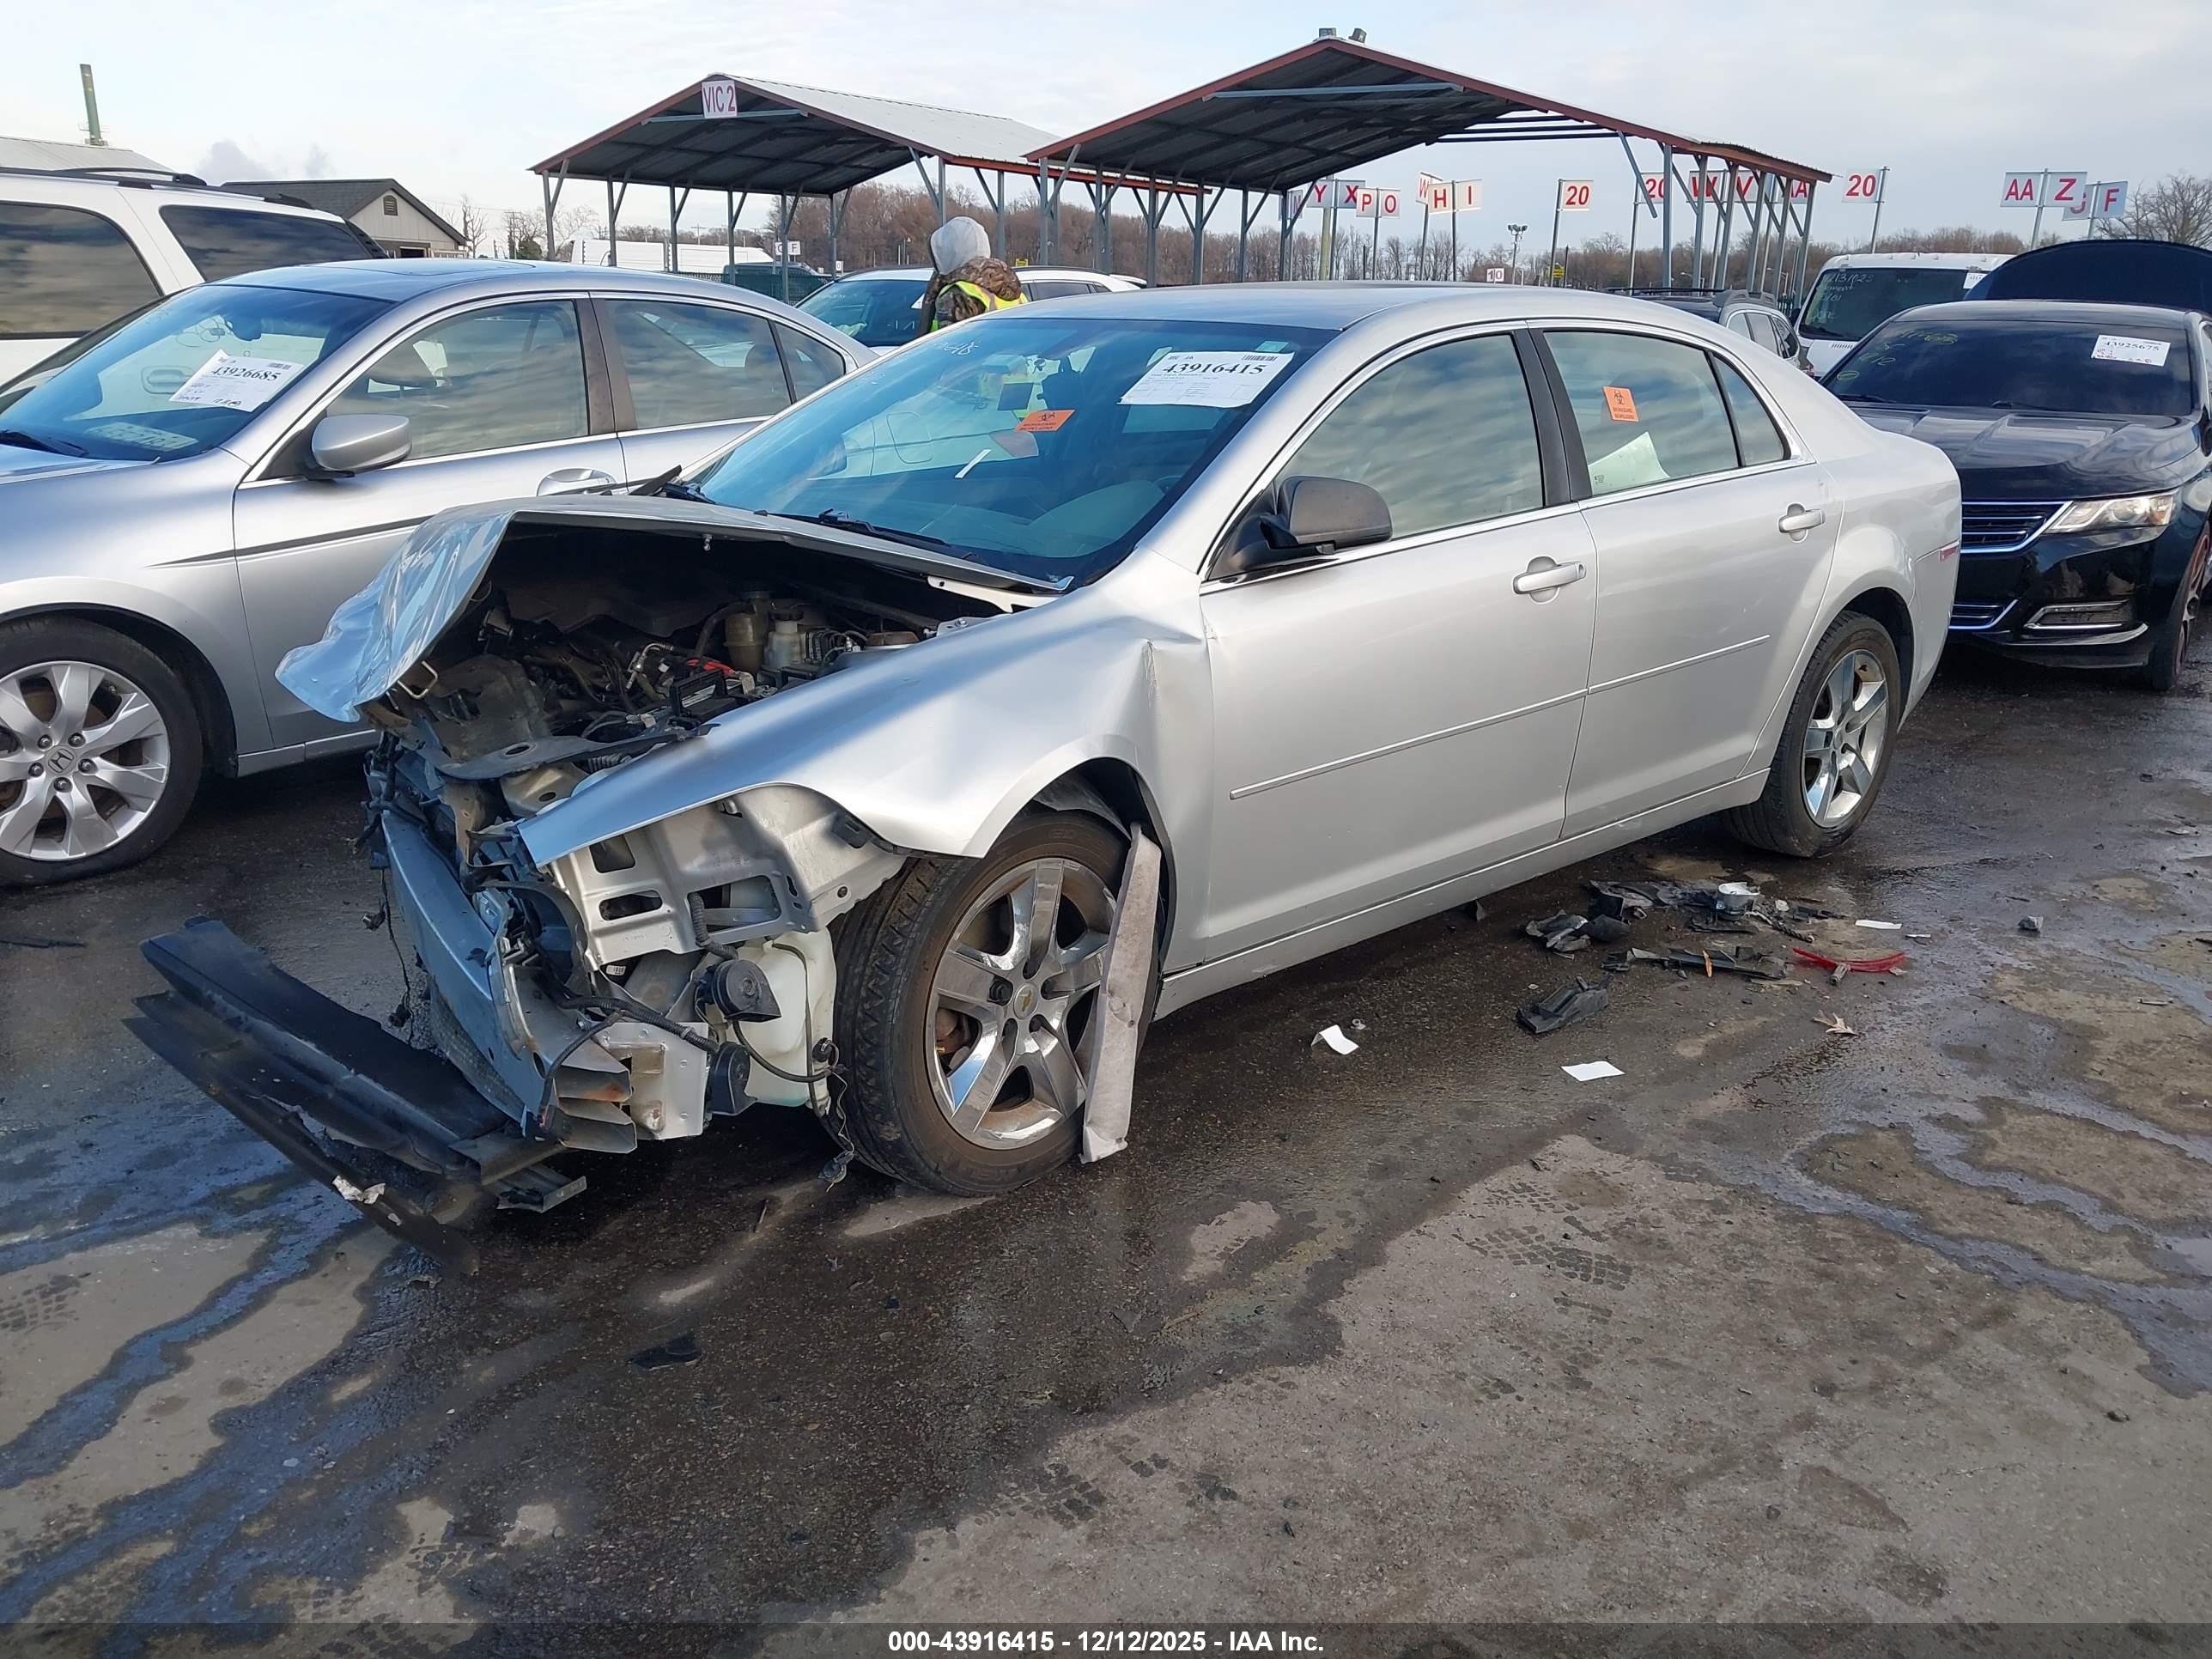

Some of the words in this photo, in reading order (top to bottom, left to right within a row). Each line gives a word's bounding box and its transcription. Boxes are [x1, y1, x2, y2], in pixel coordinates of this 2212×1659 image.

[703, 86, 724, 112] VIC
[726, 86, 736, 112] 2
[1314, 184, 1328, 203] Y
[1345, 185, 1359, 204] X
[1468, 185, 1472, 205] I
[1565, 185, 1590, 205] 20
[1845, 174, 1876, 197] 20
[2004, 178, 2033, 201] AA
[2054, 178, 2076, 201] Z
[1362, 193, 1371, 212] P
[1434, 189, 1447, 209] H
[2104, 188, 2119, 212] F
[791, 243, 797, 252] F
[1487, 268, 1503, 279] 10
[211, 366, 282, 381] 43926685
[1163, 362, 1267, 374] 43916415
